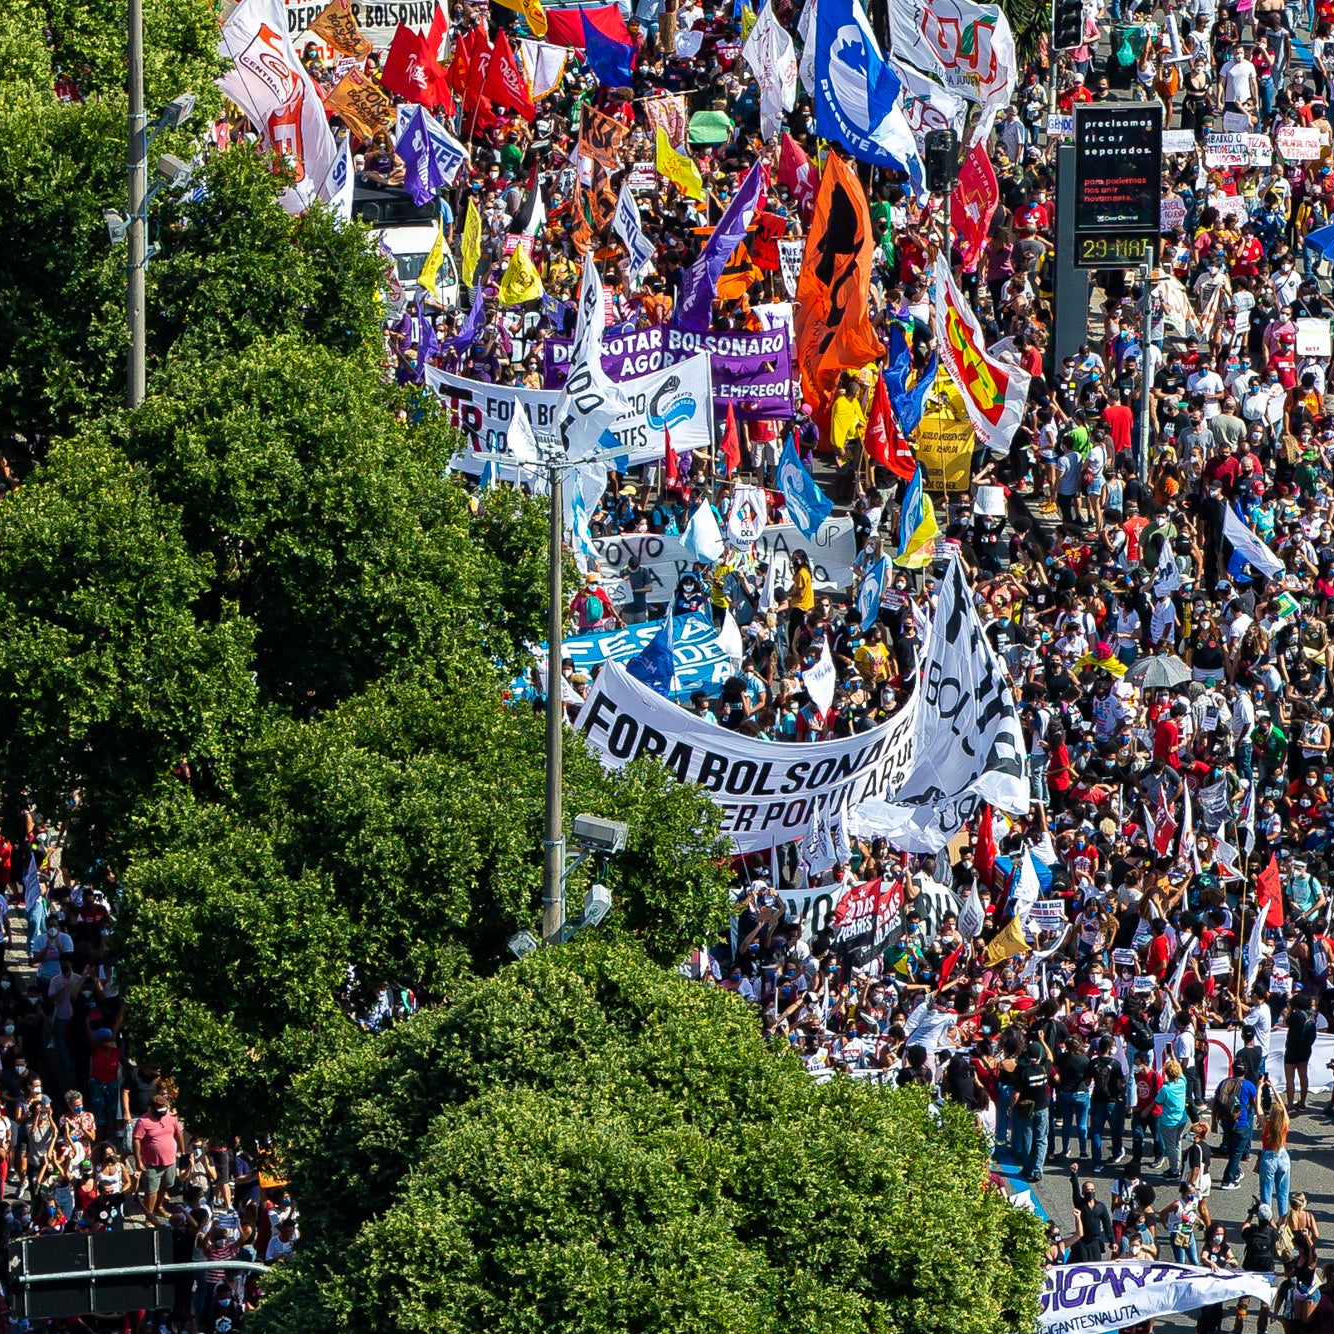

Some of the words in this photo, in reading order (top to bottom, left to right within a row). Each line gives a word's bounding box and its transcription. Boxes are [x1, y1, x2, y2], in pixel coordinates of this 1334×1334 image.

[365, 2, 435, 27] BOLSONAR
[1084, 118, 1152, 131] precisamos
[1084, 134, 1124, 143] ficar
[1084, 147, 1152, 159] separados.
[1084, 188, 1099, 196] nos
[668, 328, 785, 359] BOLSONARO
[720, 377, 790, 401] EMPREGO!
